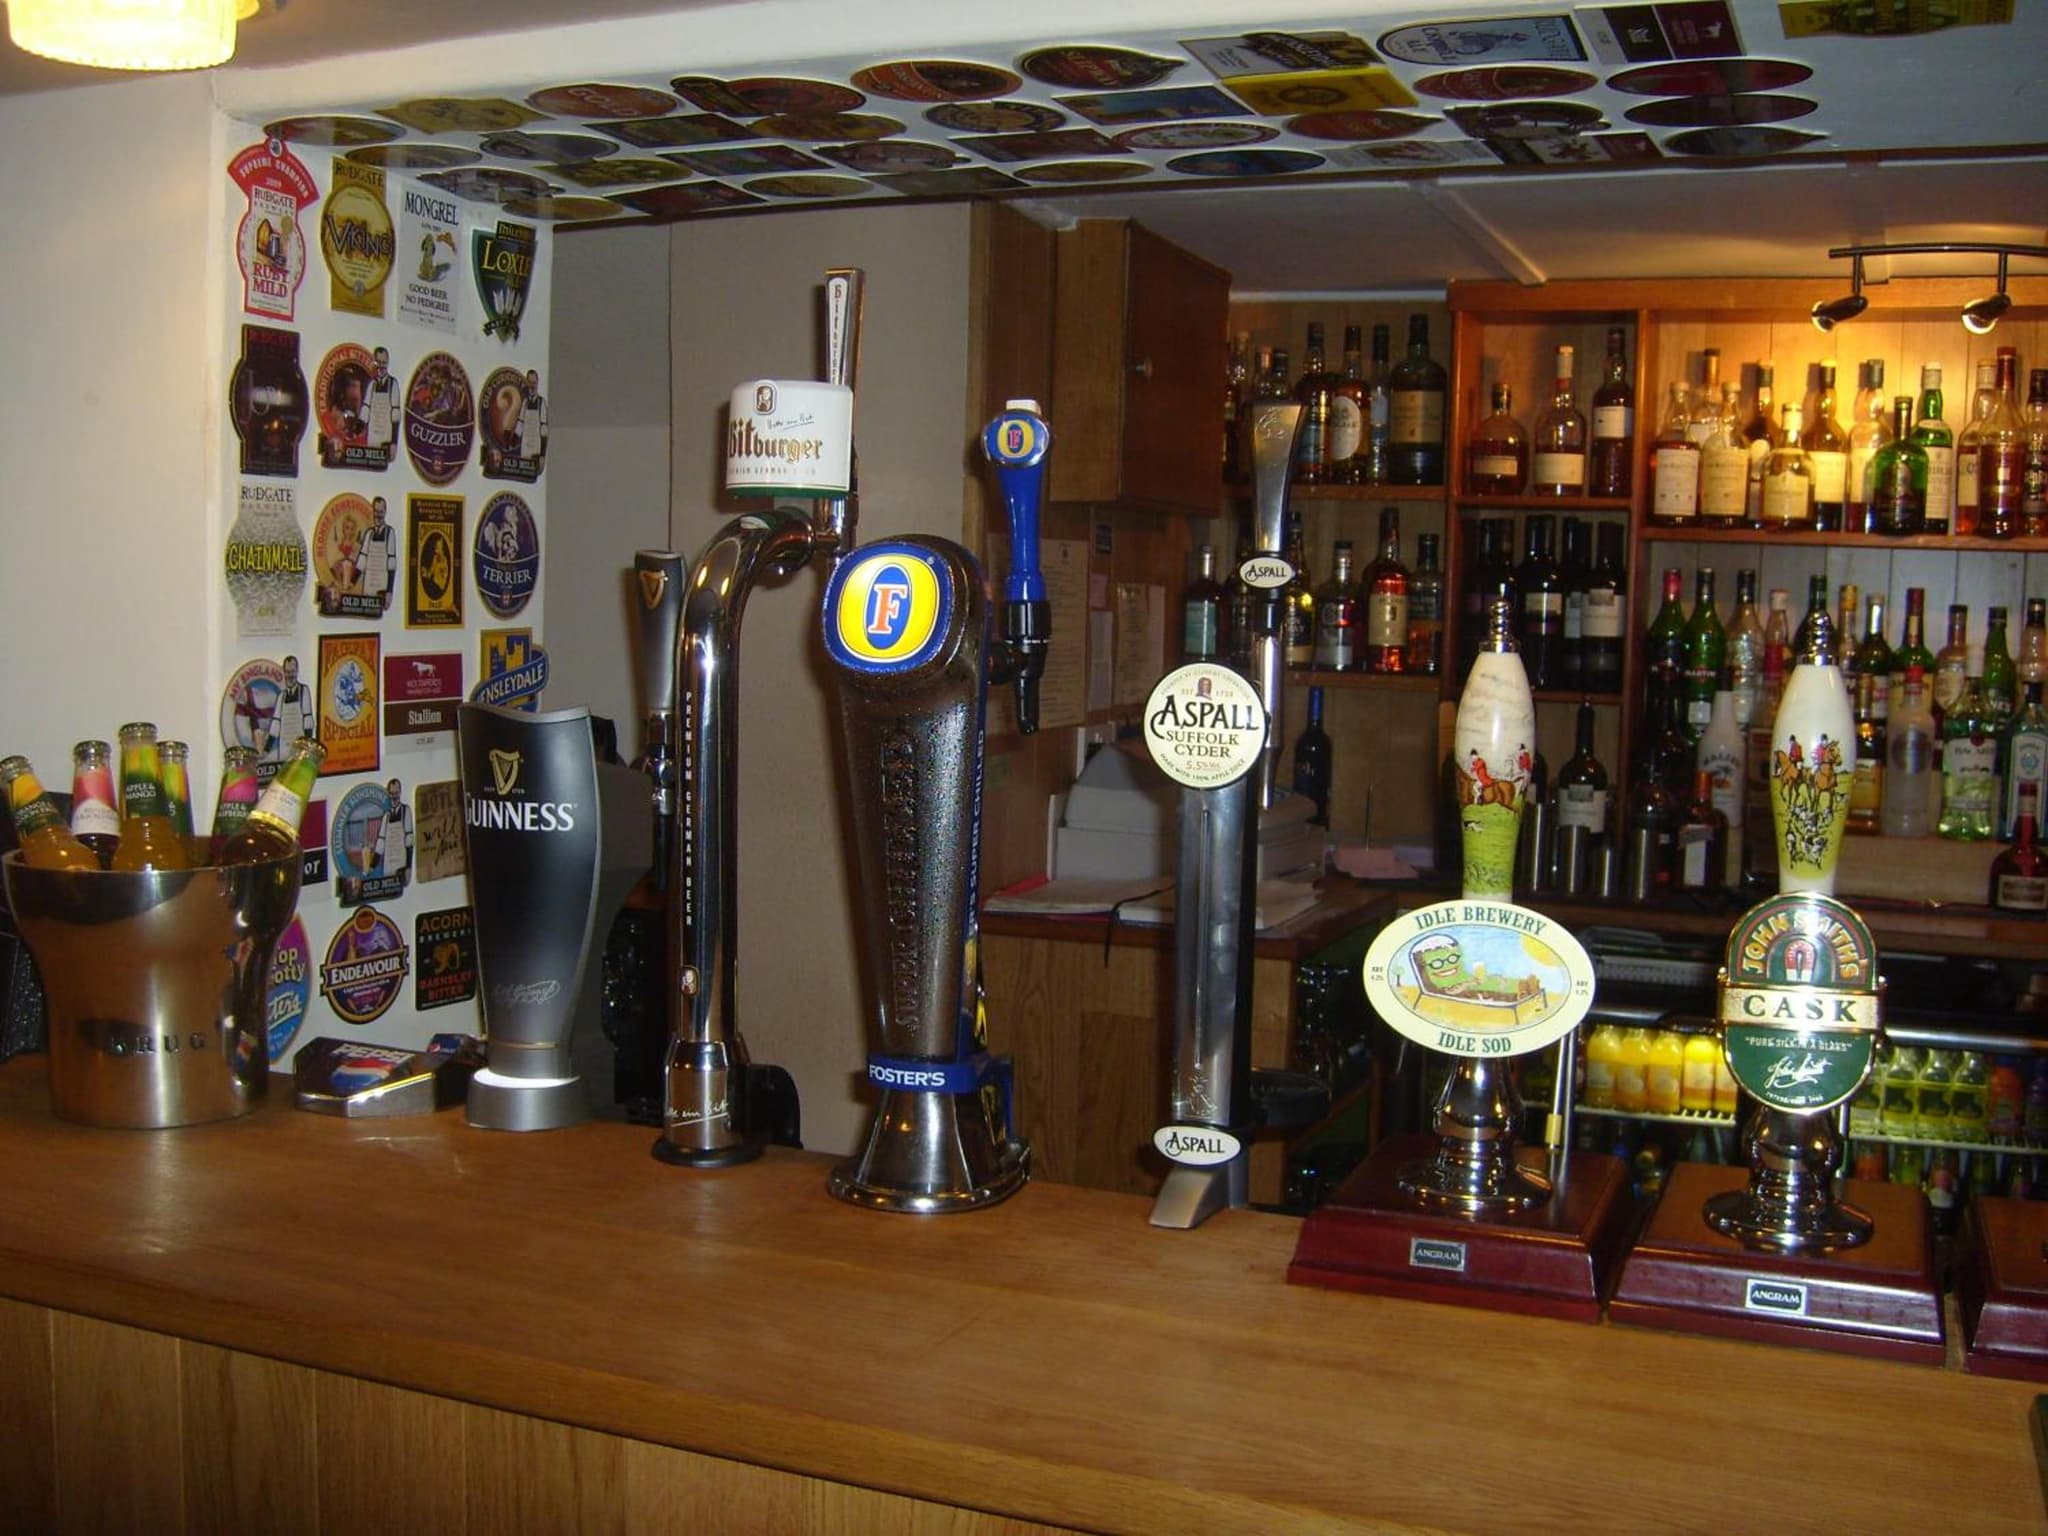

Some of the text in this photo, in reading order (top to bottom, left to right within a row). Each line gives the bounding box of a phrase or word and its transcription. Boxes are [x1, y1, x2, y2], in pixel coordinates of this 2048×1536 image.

[336, 162, 385, 186] RUDGATE
[254, 187, 294, 209] RUDGATE
[405, 191, 459, 226] MONGREL
[253, 262, 290, 283] RUBY
[252, 277, 288, 297] MILD
[409, 283, 448, 300] GOOD BEER
[405, 295, 450, 312] NO PEDIGREE
[411, 422, 466, 447] GUZZLER
[346, 448, 386, 460] OLD MILL
[504, 458, 518, 468] OLD
[241, 486, 293, 503] RUDGATE
[229, 543, 305, 572] CHAINMAIL
[482, 565, 532, 584] TERRIER
[342, 596, 360, 607] OLD
[867, 583, 908, 634] F
[240, 665, 284, 688] ENGLAND
[478, 663, 544, 703] ENSLEYDALE
[408, 708, 443, 726] Stallion
[1150, 694, 1260, 740] ASPALL
[1166, 730, 1239, 745] SUFFOLK
[1174, 744, 1231, 758] CYDER
[257, 766, 276, 776] OLD
[465, 792, 575, 832] GUINNESS
[969, 729, 984, 889] SUPER CHILLED
[363, 880, 380, 891] OLD
[420, 911, 472, 934] ACORN
[1414, 907, 1548, 935] IDLE BREWERY
[1742, 912, 1791, 974] JOHN
[331, 955, 401, 985] ENDEAVOUR
[428, 982, 465, 1000] BITTER
[1743, 994, 1857, 1022] CASK
[1437, 1031, 1512, 1053] IDLE SOD
[868, 1064, 946, 1087] FOSTER'S
[1165, 1130, 1225, 1157] ASPALL
[1416, 1248, 1460, 1261] ANGRAM
[1752, 1290, 1800, 1304] ANGRAM
